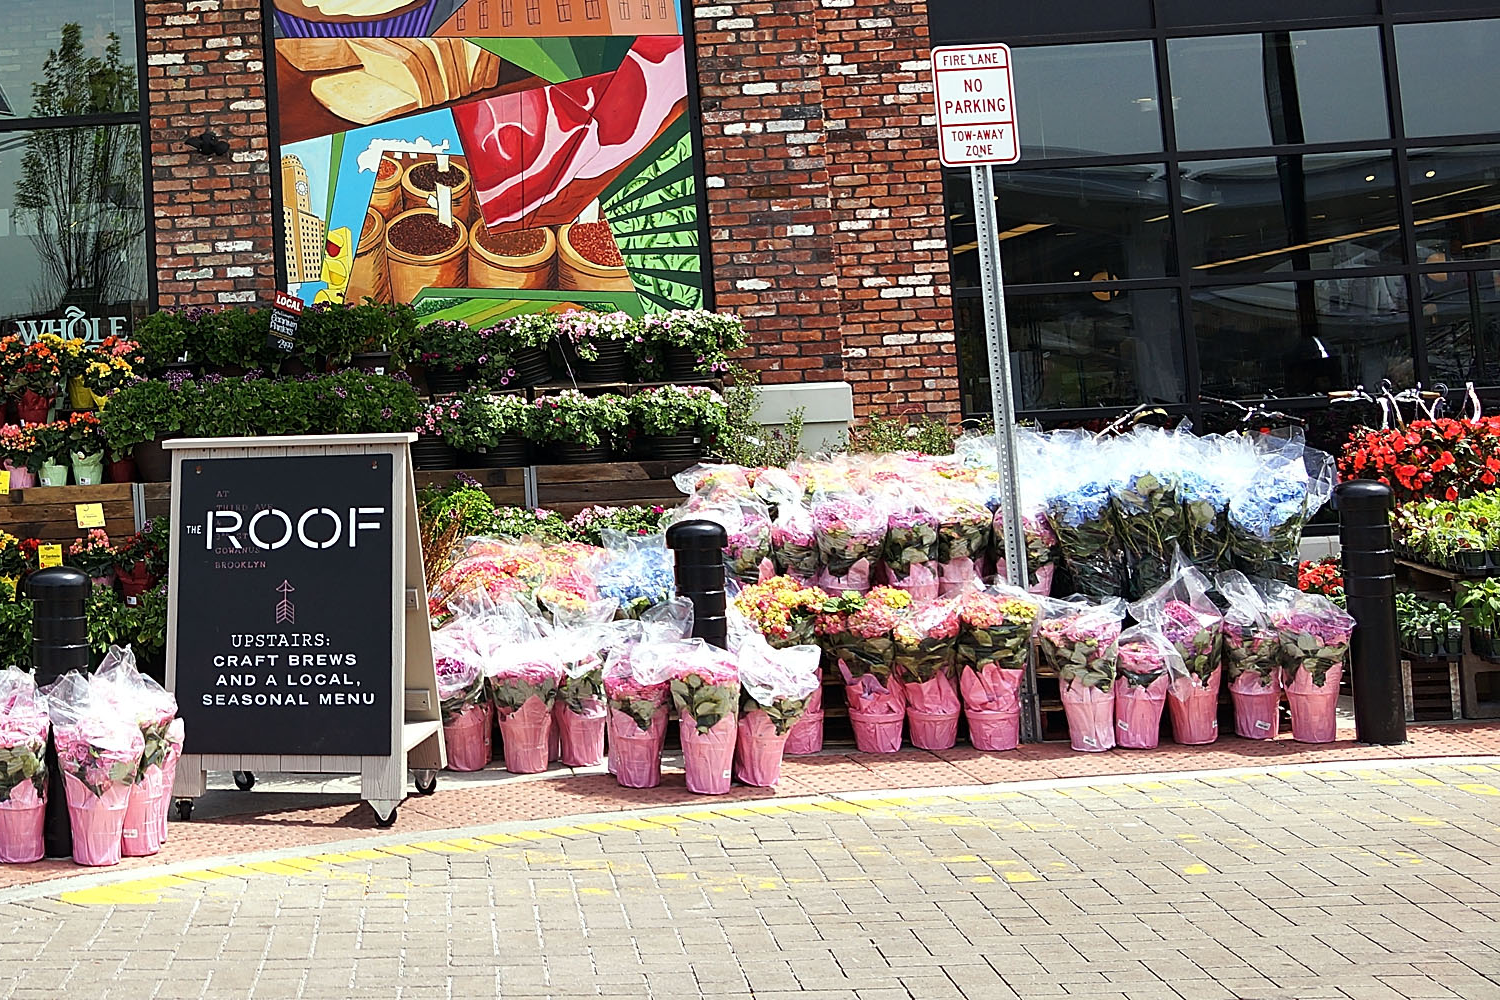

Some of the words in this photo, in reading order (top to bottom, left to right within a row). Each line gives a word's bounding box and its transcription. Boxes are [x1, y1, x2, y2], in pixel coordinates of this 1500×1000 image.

[943, 54, 966, 66] FIRE
[971, 52, 999, 65] LANE
[963, 78, 983, 92] NO
[945, 98, 1006, 114] PARKING
[951, 129, 1004, 142] TOW-AWAY
[965, 144, 994, 157] ZONE
[276, 294, 301, 312] LOCAL
[15, 305, 129, 346] WHOLE
[186, 525, 202, 534] THE
[206, 507, 385, 550] ROOF
[215, 560, 267, 569] BROOKLYN
[231, 633, 332, 648] UPSTAIRS:
[213, 654, 279, 667] CRAFT
[288, 653, 357, 666] BREWS
[215, 674, 256, 686] AND
[265, 674, 278, 686] A
[287, 673, 361, 687] LOCAL,
[202, 694, 309, 706] SEASONAL
[319, 693, 375, 705] MENU
